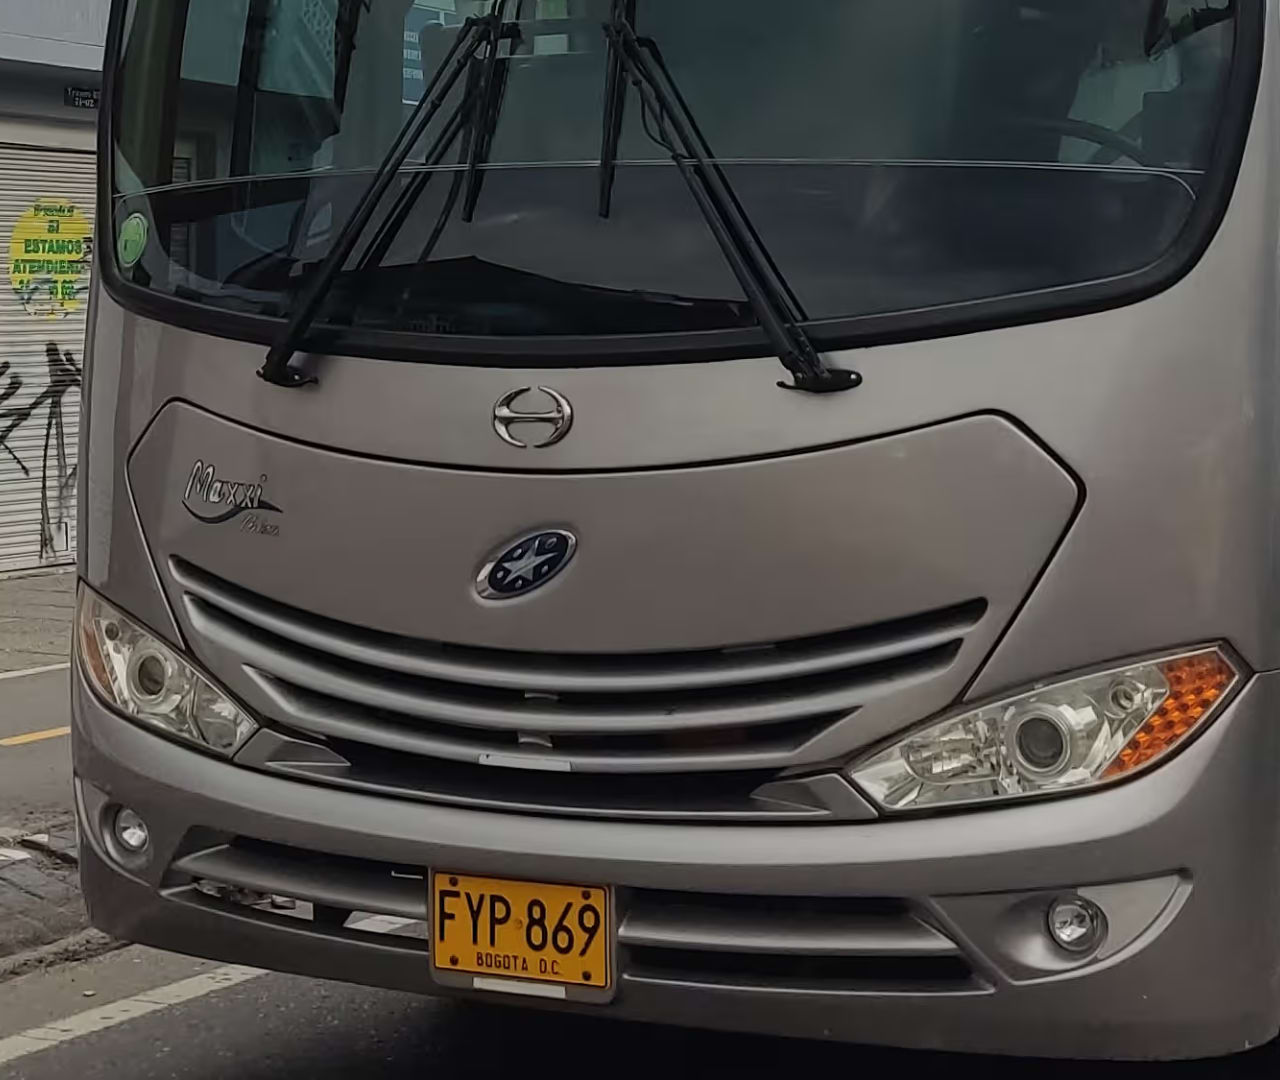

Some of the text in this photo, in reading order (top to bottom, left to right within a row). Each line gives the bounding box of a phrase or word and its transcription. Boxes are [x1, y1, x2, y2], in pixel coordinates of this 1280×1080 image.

[24, 239, 82, 255] ESTAMOS
[439, 890, 601, 957] FYP 869
[476, 951, 529, 972] BOGOTA
